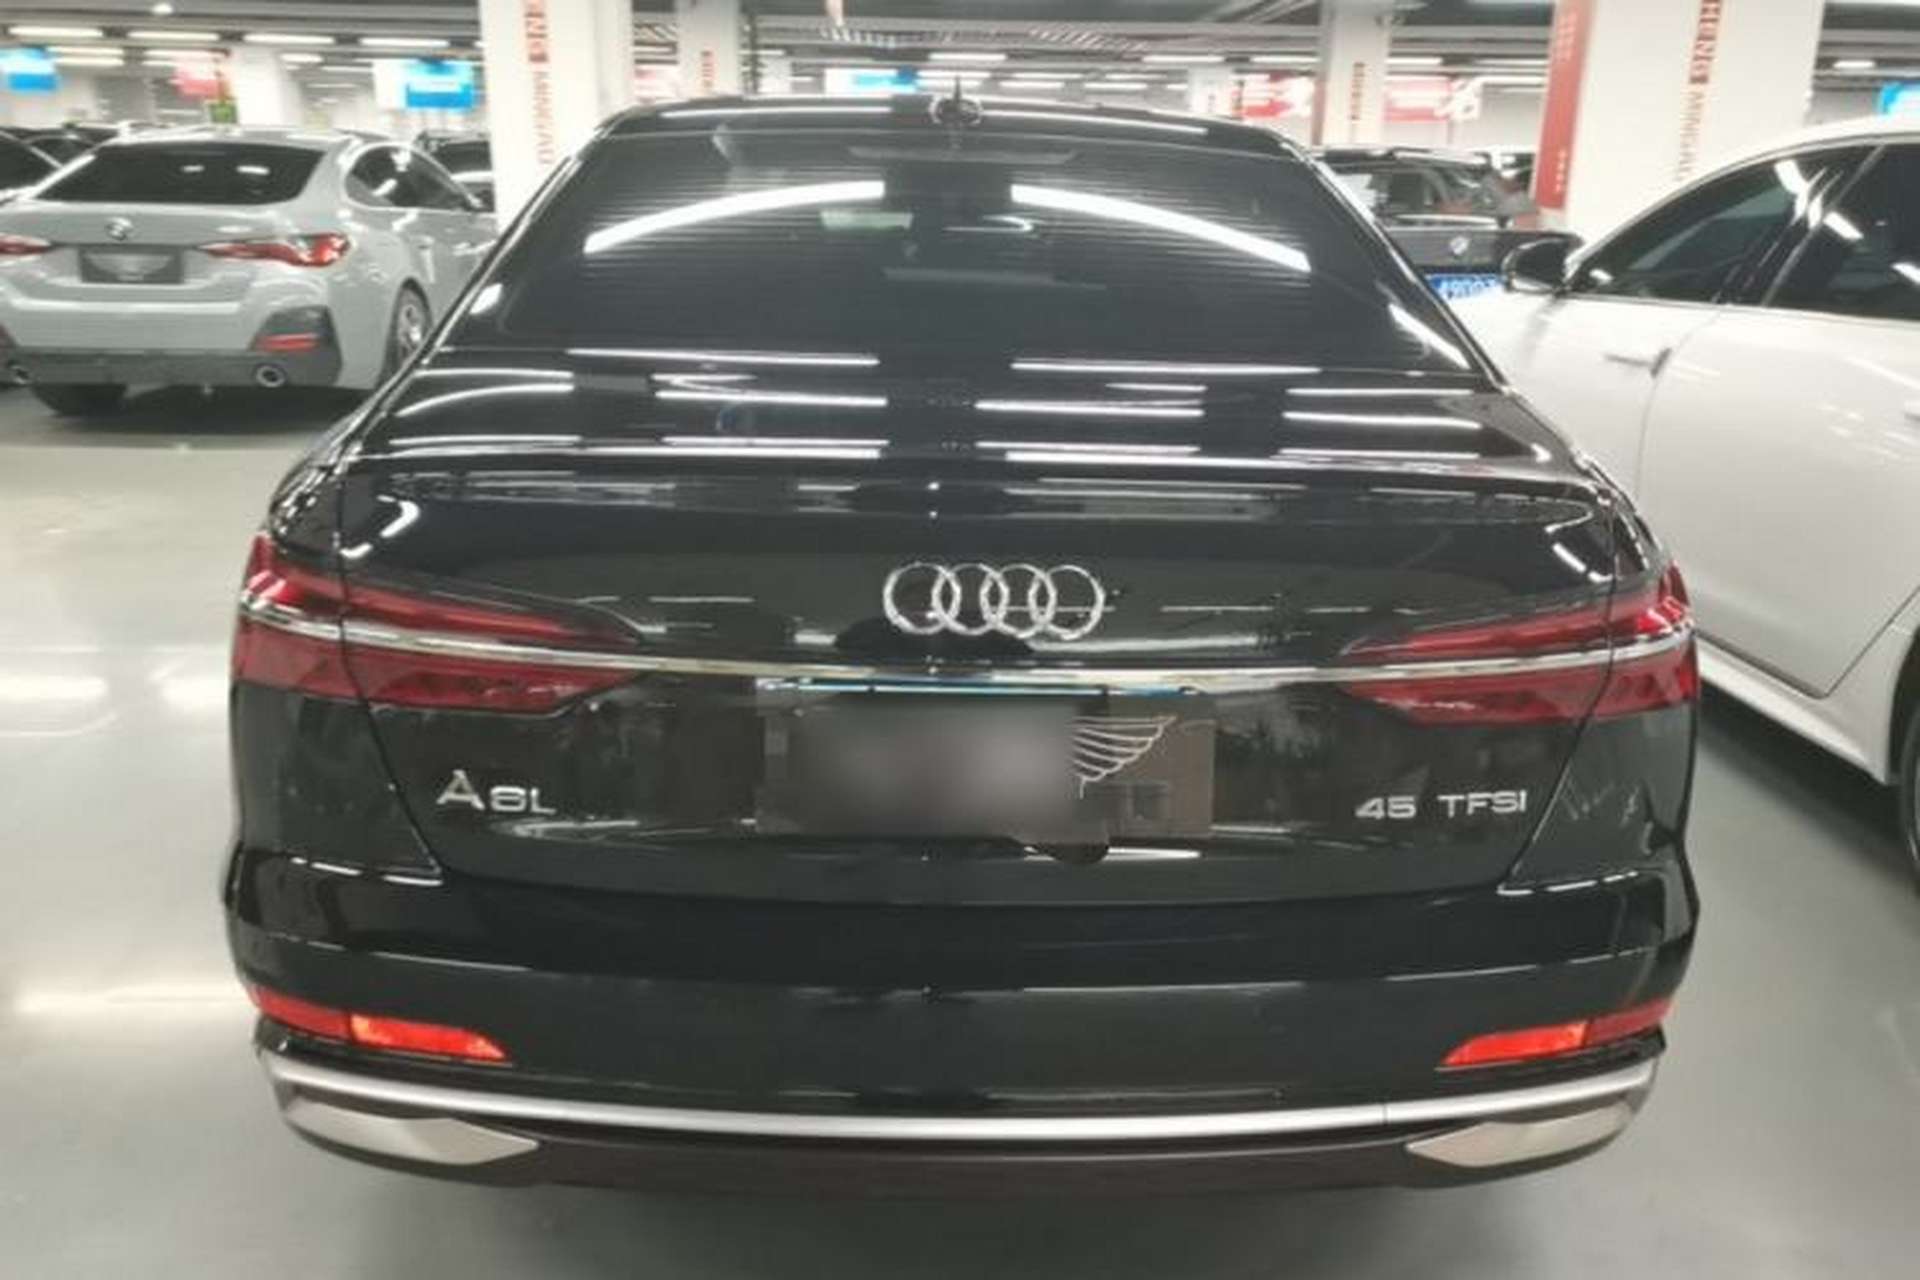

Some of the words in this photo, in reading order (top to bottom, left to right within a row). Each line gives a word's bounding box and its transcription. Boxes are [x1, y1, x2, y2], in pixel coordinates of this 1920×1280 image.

[436, 768, 557, 815] A6L
[1355, 796, 1416, 819] 45
[1436, 789, 1527, 818] TFSI
